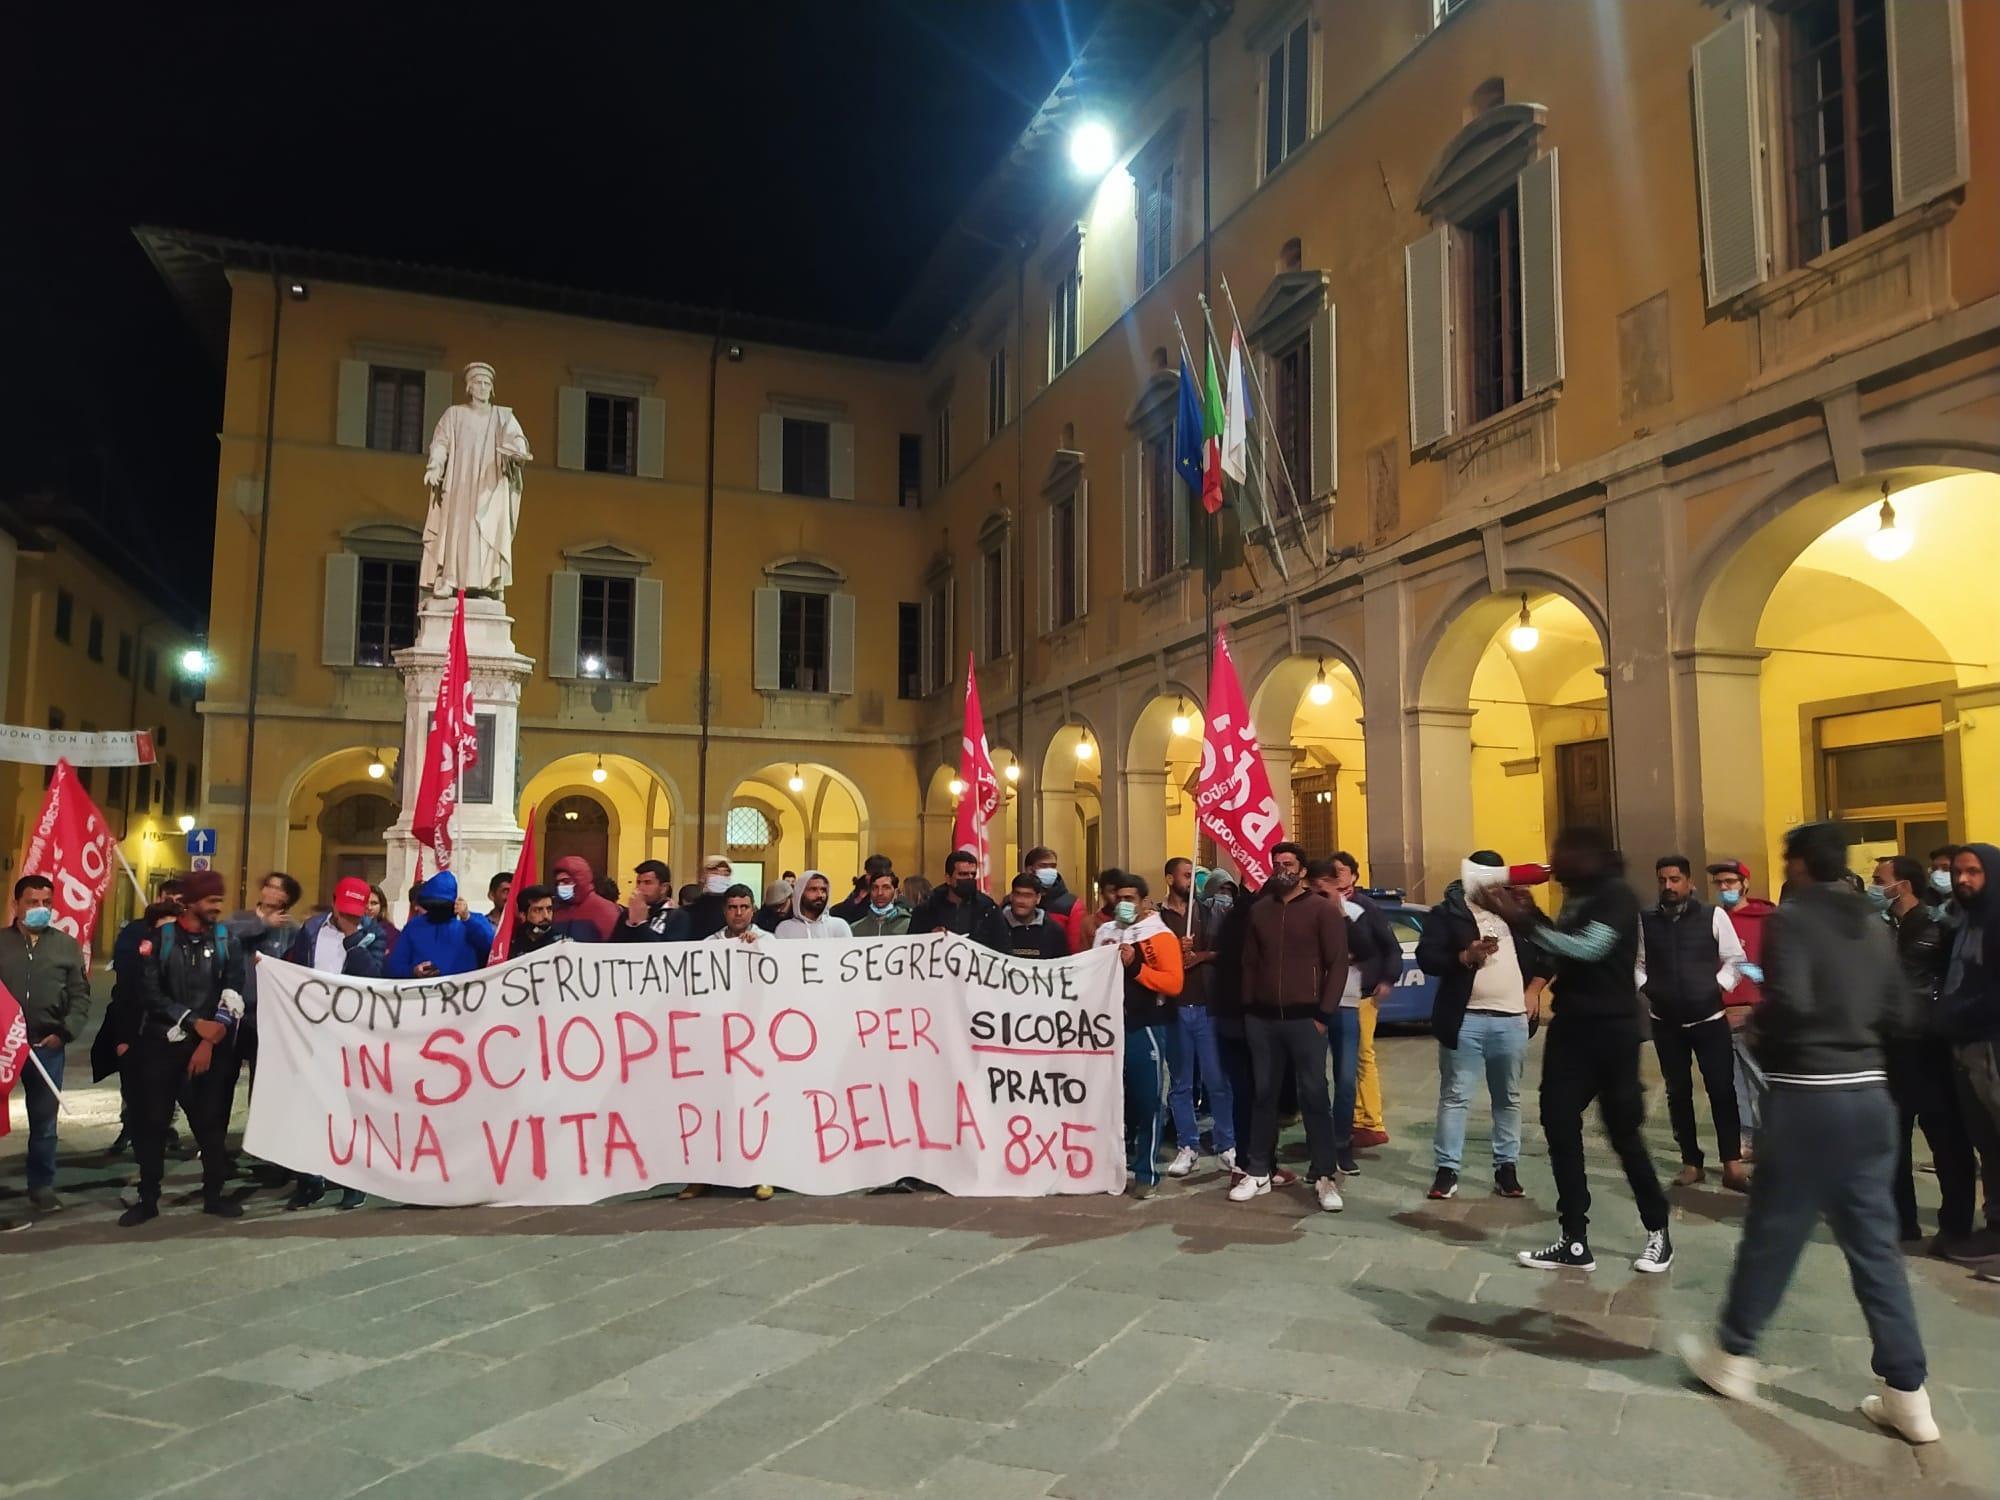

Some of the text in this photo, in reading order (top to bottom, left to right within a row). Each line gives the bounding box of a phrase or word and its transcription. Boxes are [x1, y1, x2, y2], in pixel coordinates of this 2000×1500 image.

[49, 734, 77, 744] CON
[101, 735, 136, 744] CANE
[294, 978, 487, 1030] CONTRO
[501, 948, 779, 1007] SFRUTTAMENTO
[801, 952, 824, 984] E
[840, 937, 1080, 1001] SEGREGAZIONE
[341, 1007, 940, 1105] IN SCIOPERO PER
[970, 1009, 1116, 1050] SICOBAS
[987, 1067, 1087, 1106] PRATO
[328, 1112, 450, 1183] UNA
[482, 1112, 649, 1185] VITA
[803, 1078, 986, 1164] BELLA
